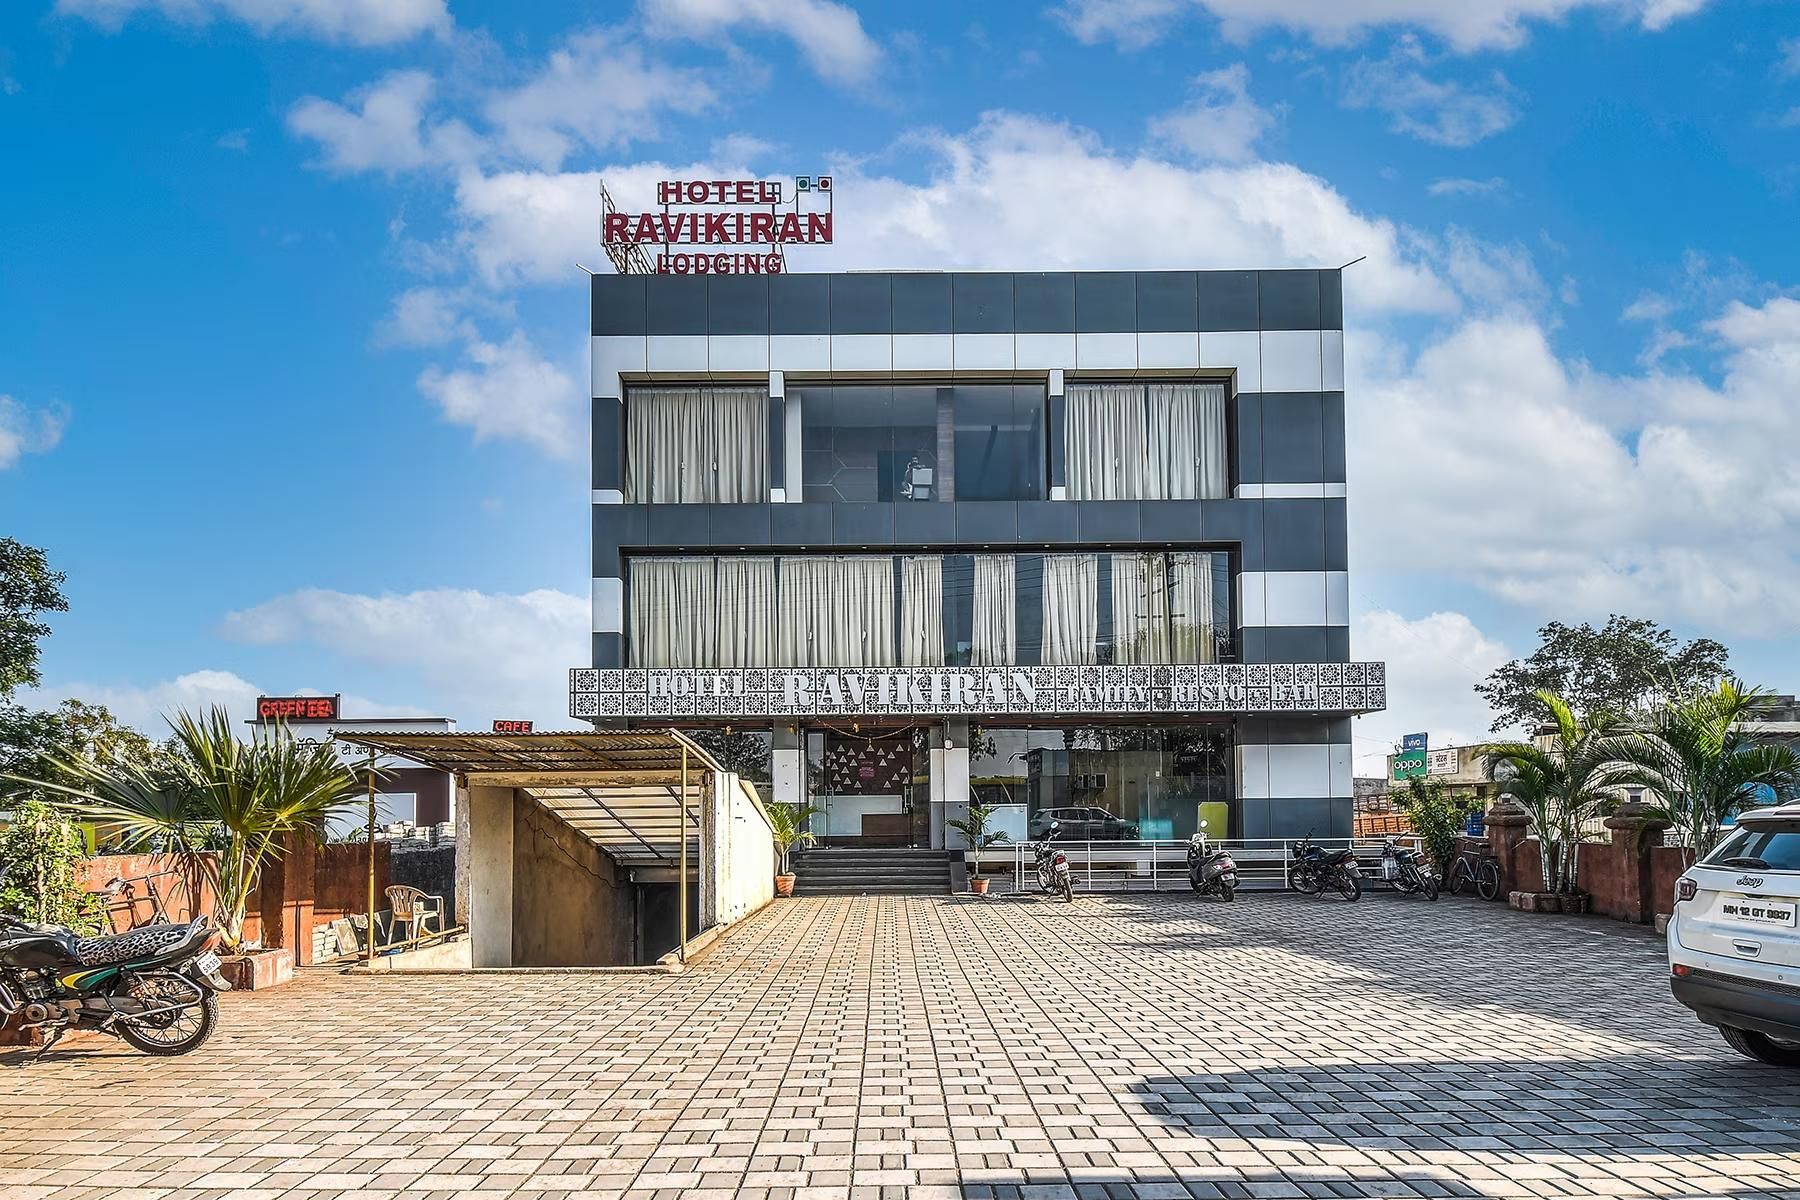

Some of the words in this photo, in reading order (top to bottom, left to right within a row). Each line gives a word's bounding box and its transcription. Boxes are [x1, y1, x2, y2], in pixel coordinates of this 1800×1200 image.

[660, 180, 777, 203] HOTEL
[604, 212, 833, 244] RAVIKIRAN
[656, 252, 782, 275] LODGING
[648, 675, 748, 697] HOTEL
[782, 673, 1038, 706] RAVIKIRAN
[1067, 686, 1149, 702] FAMILY
[1171, 684, 1243, 702] RESTO
[1271, 684, 1319, 701] BAR
[495, 721, 529, 732] CAFE
[1394, 760, 1422, 771] oppo
[1736, 875, 1763, 888] Jeep
[1723, 905, 1738, 915] MH
[1740, 907, 1750, 916] 12
